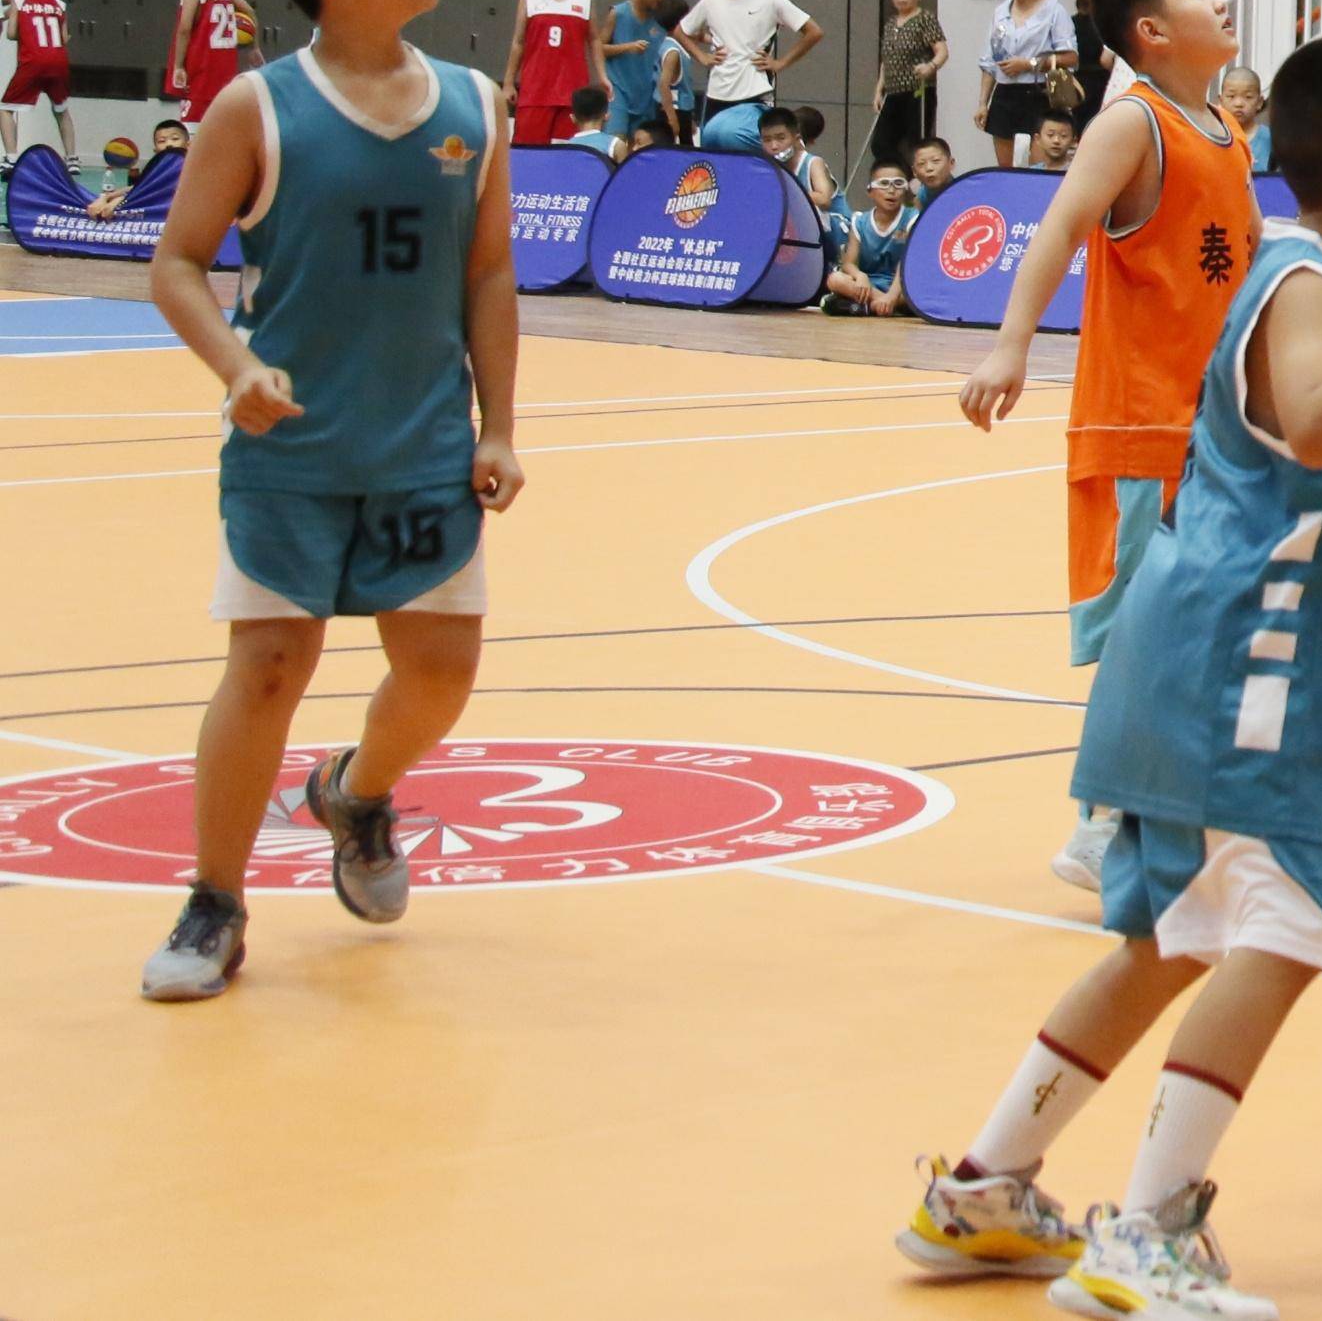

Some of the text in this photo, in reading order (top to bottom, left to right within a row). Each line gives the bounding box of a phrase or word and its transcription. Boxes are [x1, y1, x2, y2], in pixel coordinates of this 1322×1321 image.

[32, 16, 63, 48] 11
[209, 3, 238, 49] 23
[548, 26, 563, 47] 9
[511, 193, 590, 212] 力运动生活馆
[674, 189, 719, 213] BASKETBALL
[517, 213, 583, 227] TOTAL FITNESS
[355, 206, 424, 276] 15
[638, 236, 674, 253] 2022年
[612, 251, 741, 275] 全国社区运动会街头篮球系列赛
[557, 745, 754, 768] CLUB
